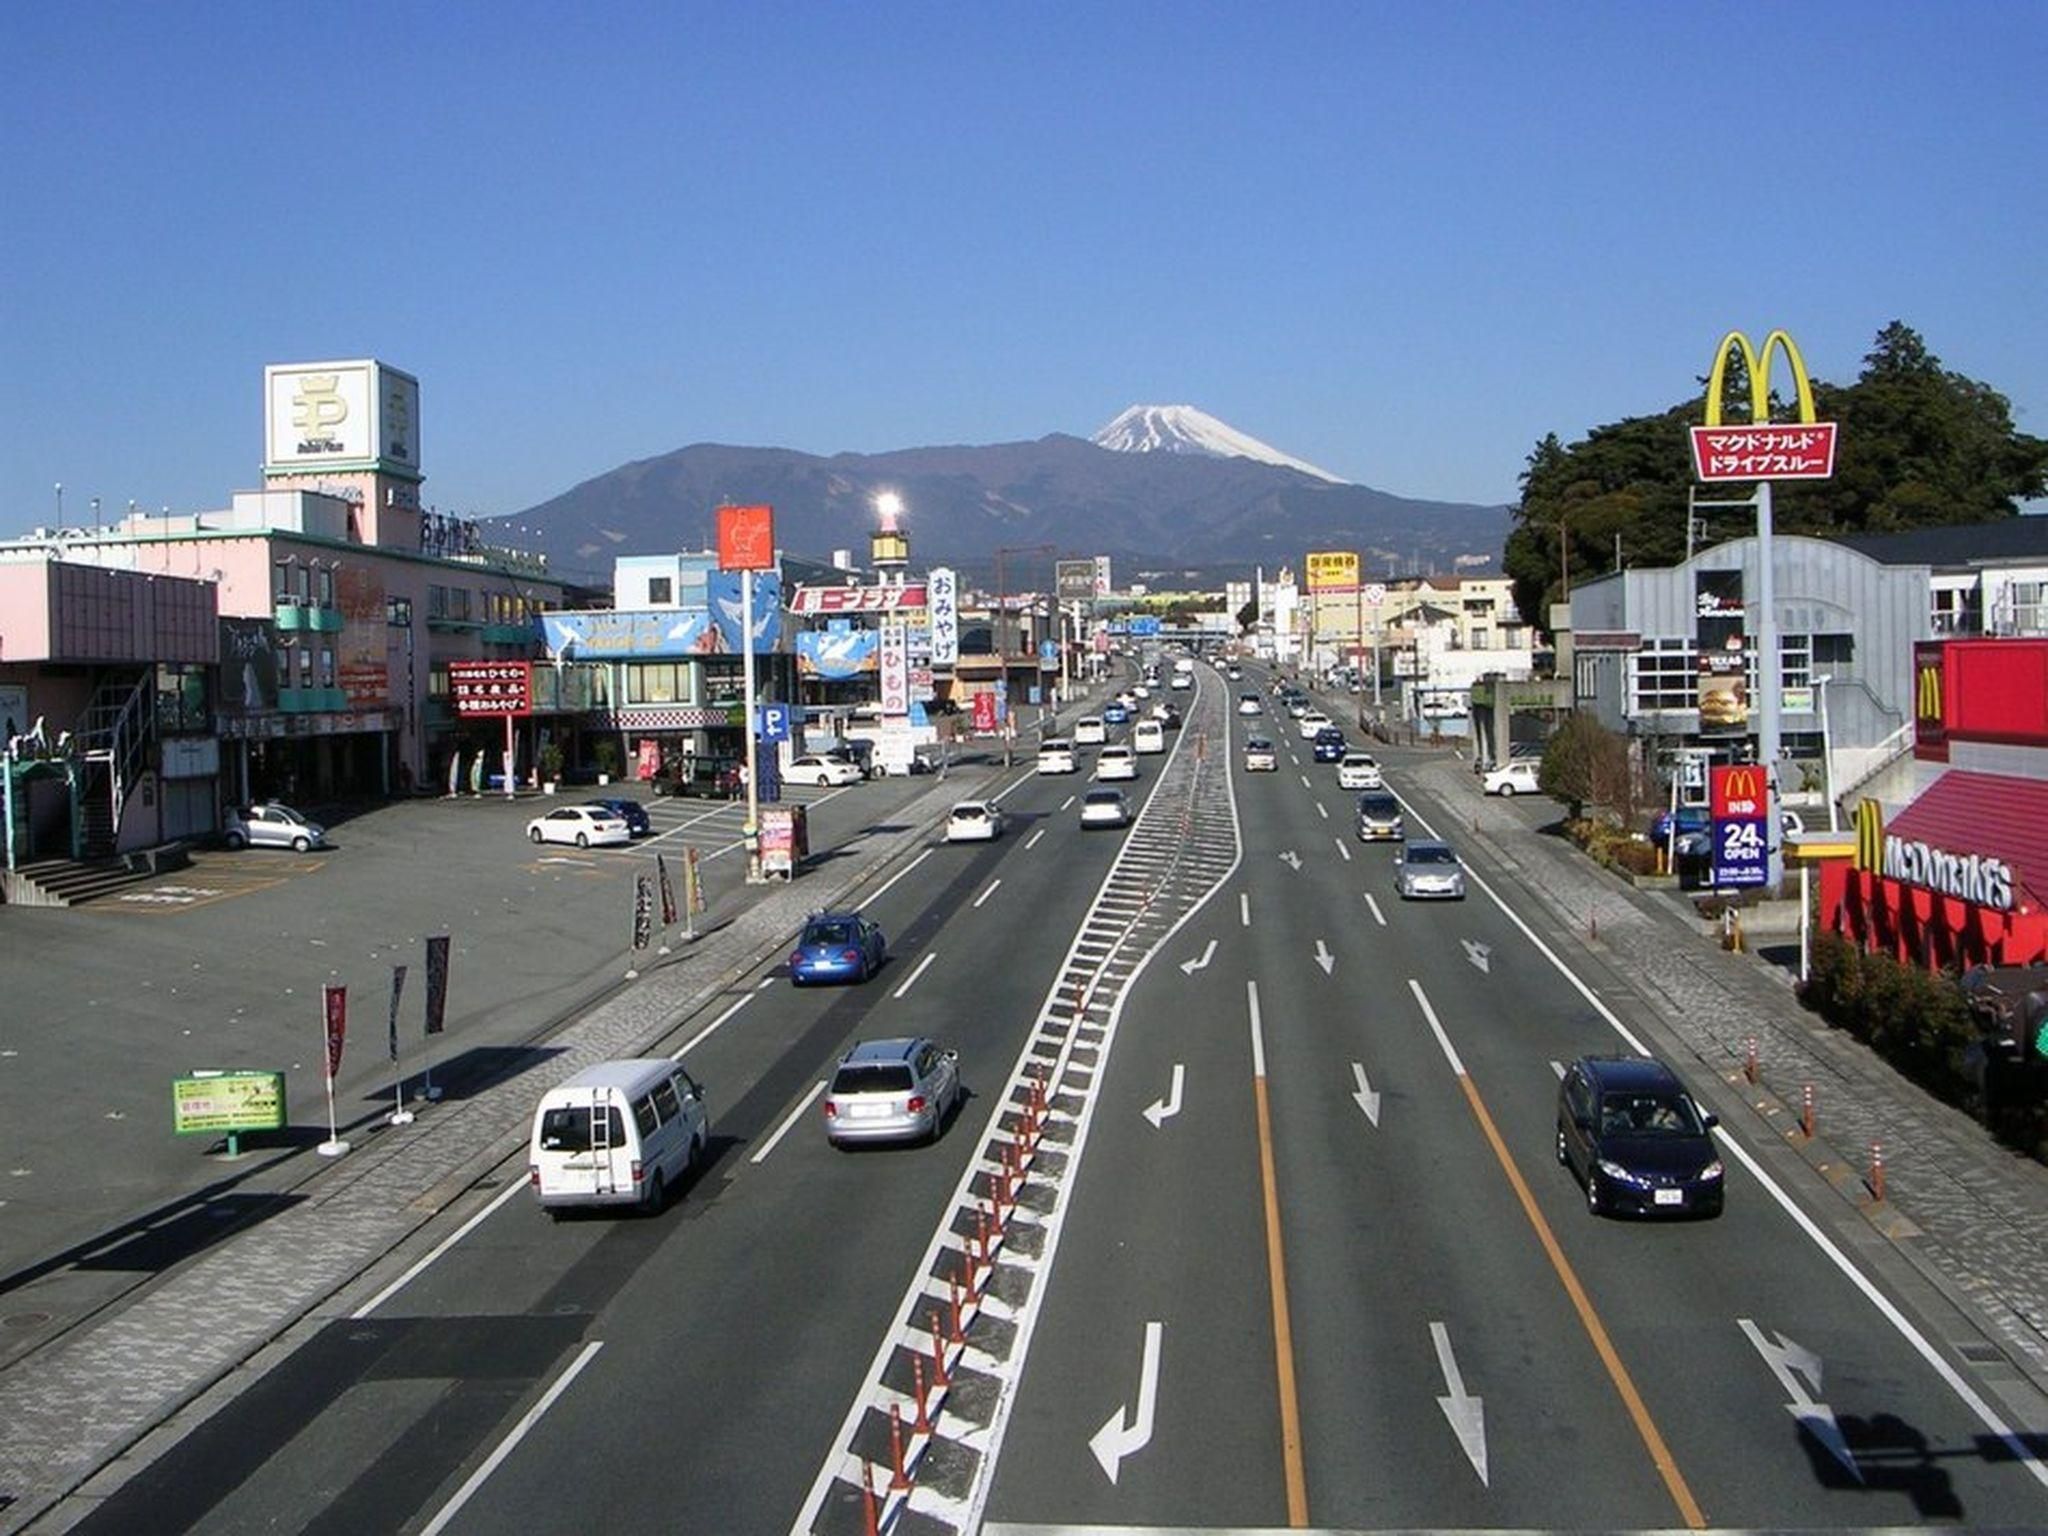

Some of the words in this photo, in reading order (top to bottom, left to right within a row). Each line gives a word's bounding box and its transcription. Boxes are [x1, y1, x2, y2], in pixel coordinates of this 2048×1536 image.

[1707, 432, 1815, 452] マクドナルド
[1710, 453, 1823, 473] ドライブスルー
[933, 576, 955, 660] おみやげ
[766, 710, 781, 727] P
[1724, 848, 1759, 860] OPEN
